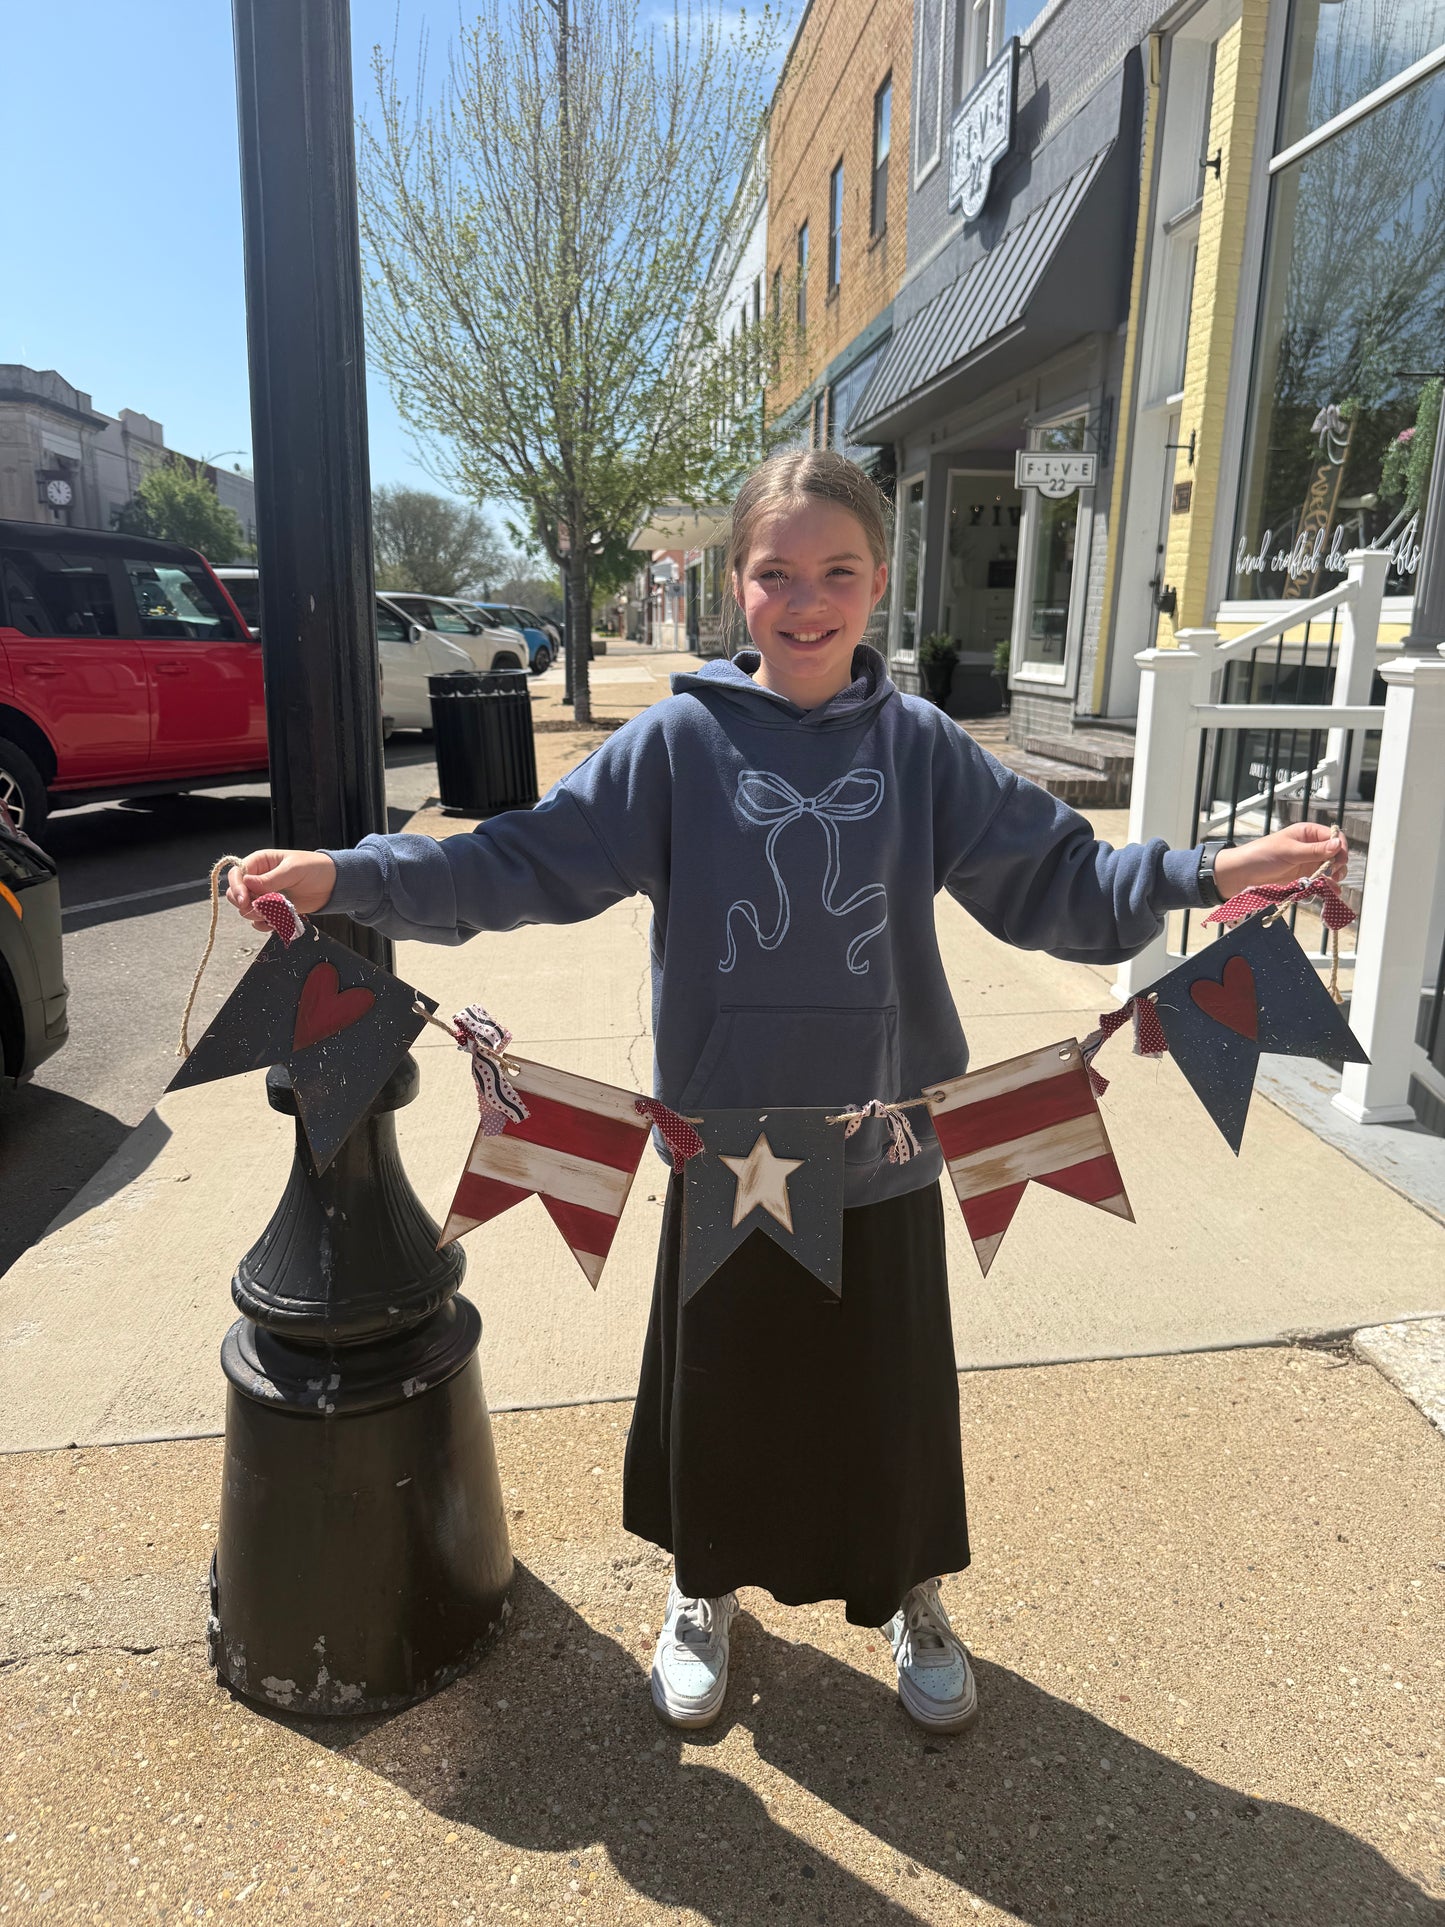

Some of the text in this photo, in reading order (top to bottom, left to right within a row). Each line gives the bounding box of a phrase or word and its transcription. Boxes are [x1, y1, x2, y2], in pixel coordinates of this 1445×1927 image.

[1048, 478, 1066, 492] 22
[1235, 529, 1272, 575] hand
[1270, 527, 1325, 580] crafted
